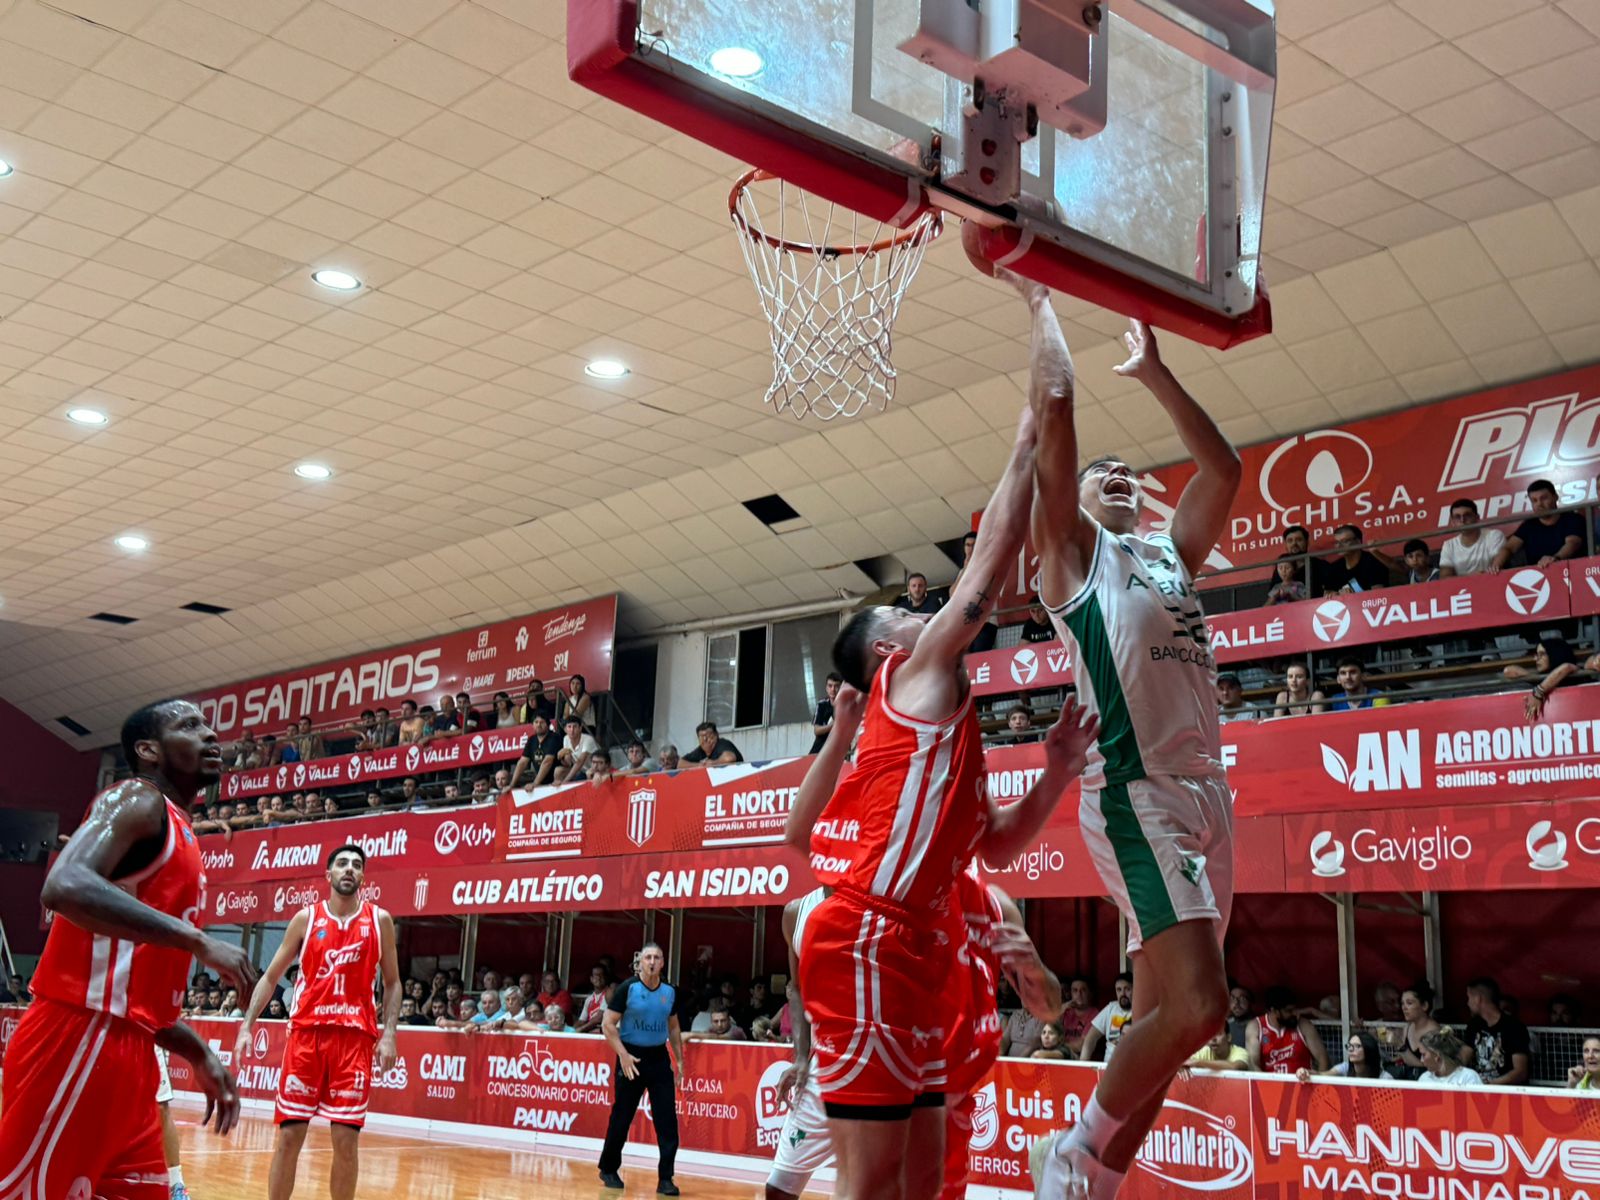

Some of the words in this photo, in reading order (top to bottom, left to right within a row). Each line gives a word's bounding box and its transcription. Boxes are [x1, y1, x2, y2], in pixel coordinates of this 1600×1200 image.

[1231, 498, 1338, 540] DUCHI
[1354, 485, 1424, 515] S.A.
[1363, 508, 1428, 529] campo
[1362, 590, 1472, 628] VALLÉ
[1209, 617, 1284, 649] ALLÉ
[467, 646, 497, 663] ferrum
[242, 647, 441, 727] SANITARIOS
[364, 756, 397, 773] VALLÉ
[423, 746, 459, 765] VALLÉ
[1353, 729, 1421, 792] AN
[241, 774, 270, 791] VALLÉ
[309, 766, 340, 782] VALLÉ
[1436, 770, 1496, 788] semillas
[705, 794, 726, 818] EL
[509, 814, 526, 835] EL
[530, 808, 583, 833] NORTE
[747, 820, 757, 829] DE
[540, 837, 550, 846] DE
[551, 835, 582, 845] SEGUROS
[1351, 826, 1472, 871] Gaviglio
[271, 844, 321, 869] AKRON
[452, 880, 504, 905] CLUB
[504, 868, 604, 904] ATLÉTICO
[643, 870, 696, 900] SAN
[699, 864, 790, 898] ISIDRO
[227, 890, 258, 913] Gaviglio
[285, 885, 319, 908] Gaviglio
[316, 941, 364, 980] Sani
[420, 1053, 467, 1082] CAMI
[427, 1085, 455, 1100] SALUD
[487, 1082, 568, 1102] CONCESIONARIO
[570, 1088, 611, 1106] OFICIAL
[681, 1077, 693, 1092] LA
[696, 1078, 723, 1094] CASA
[687, 1101, 738, 1120] TAPICERO
[1005, 1088, 1054, 1121] Luis
[513, 1107, 578, 1132] PAUNY
